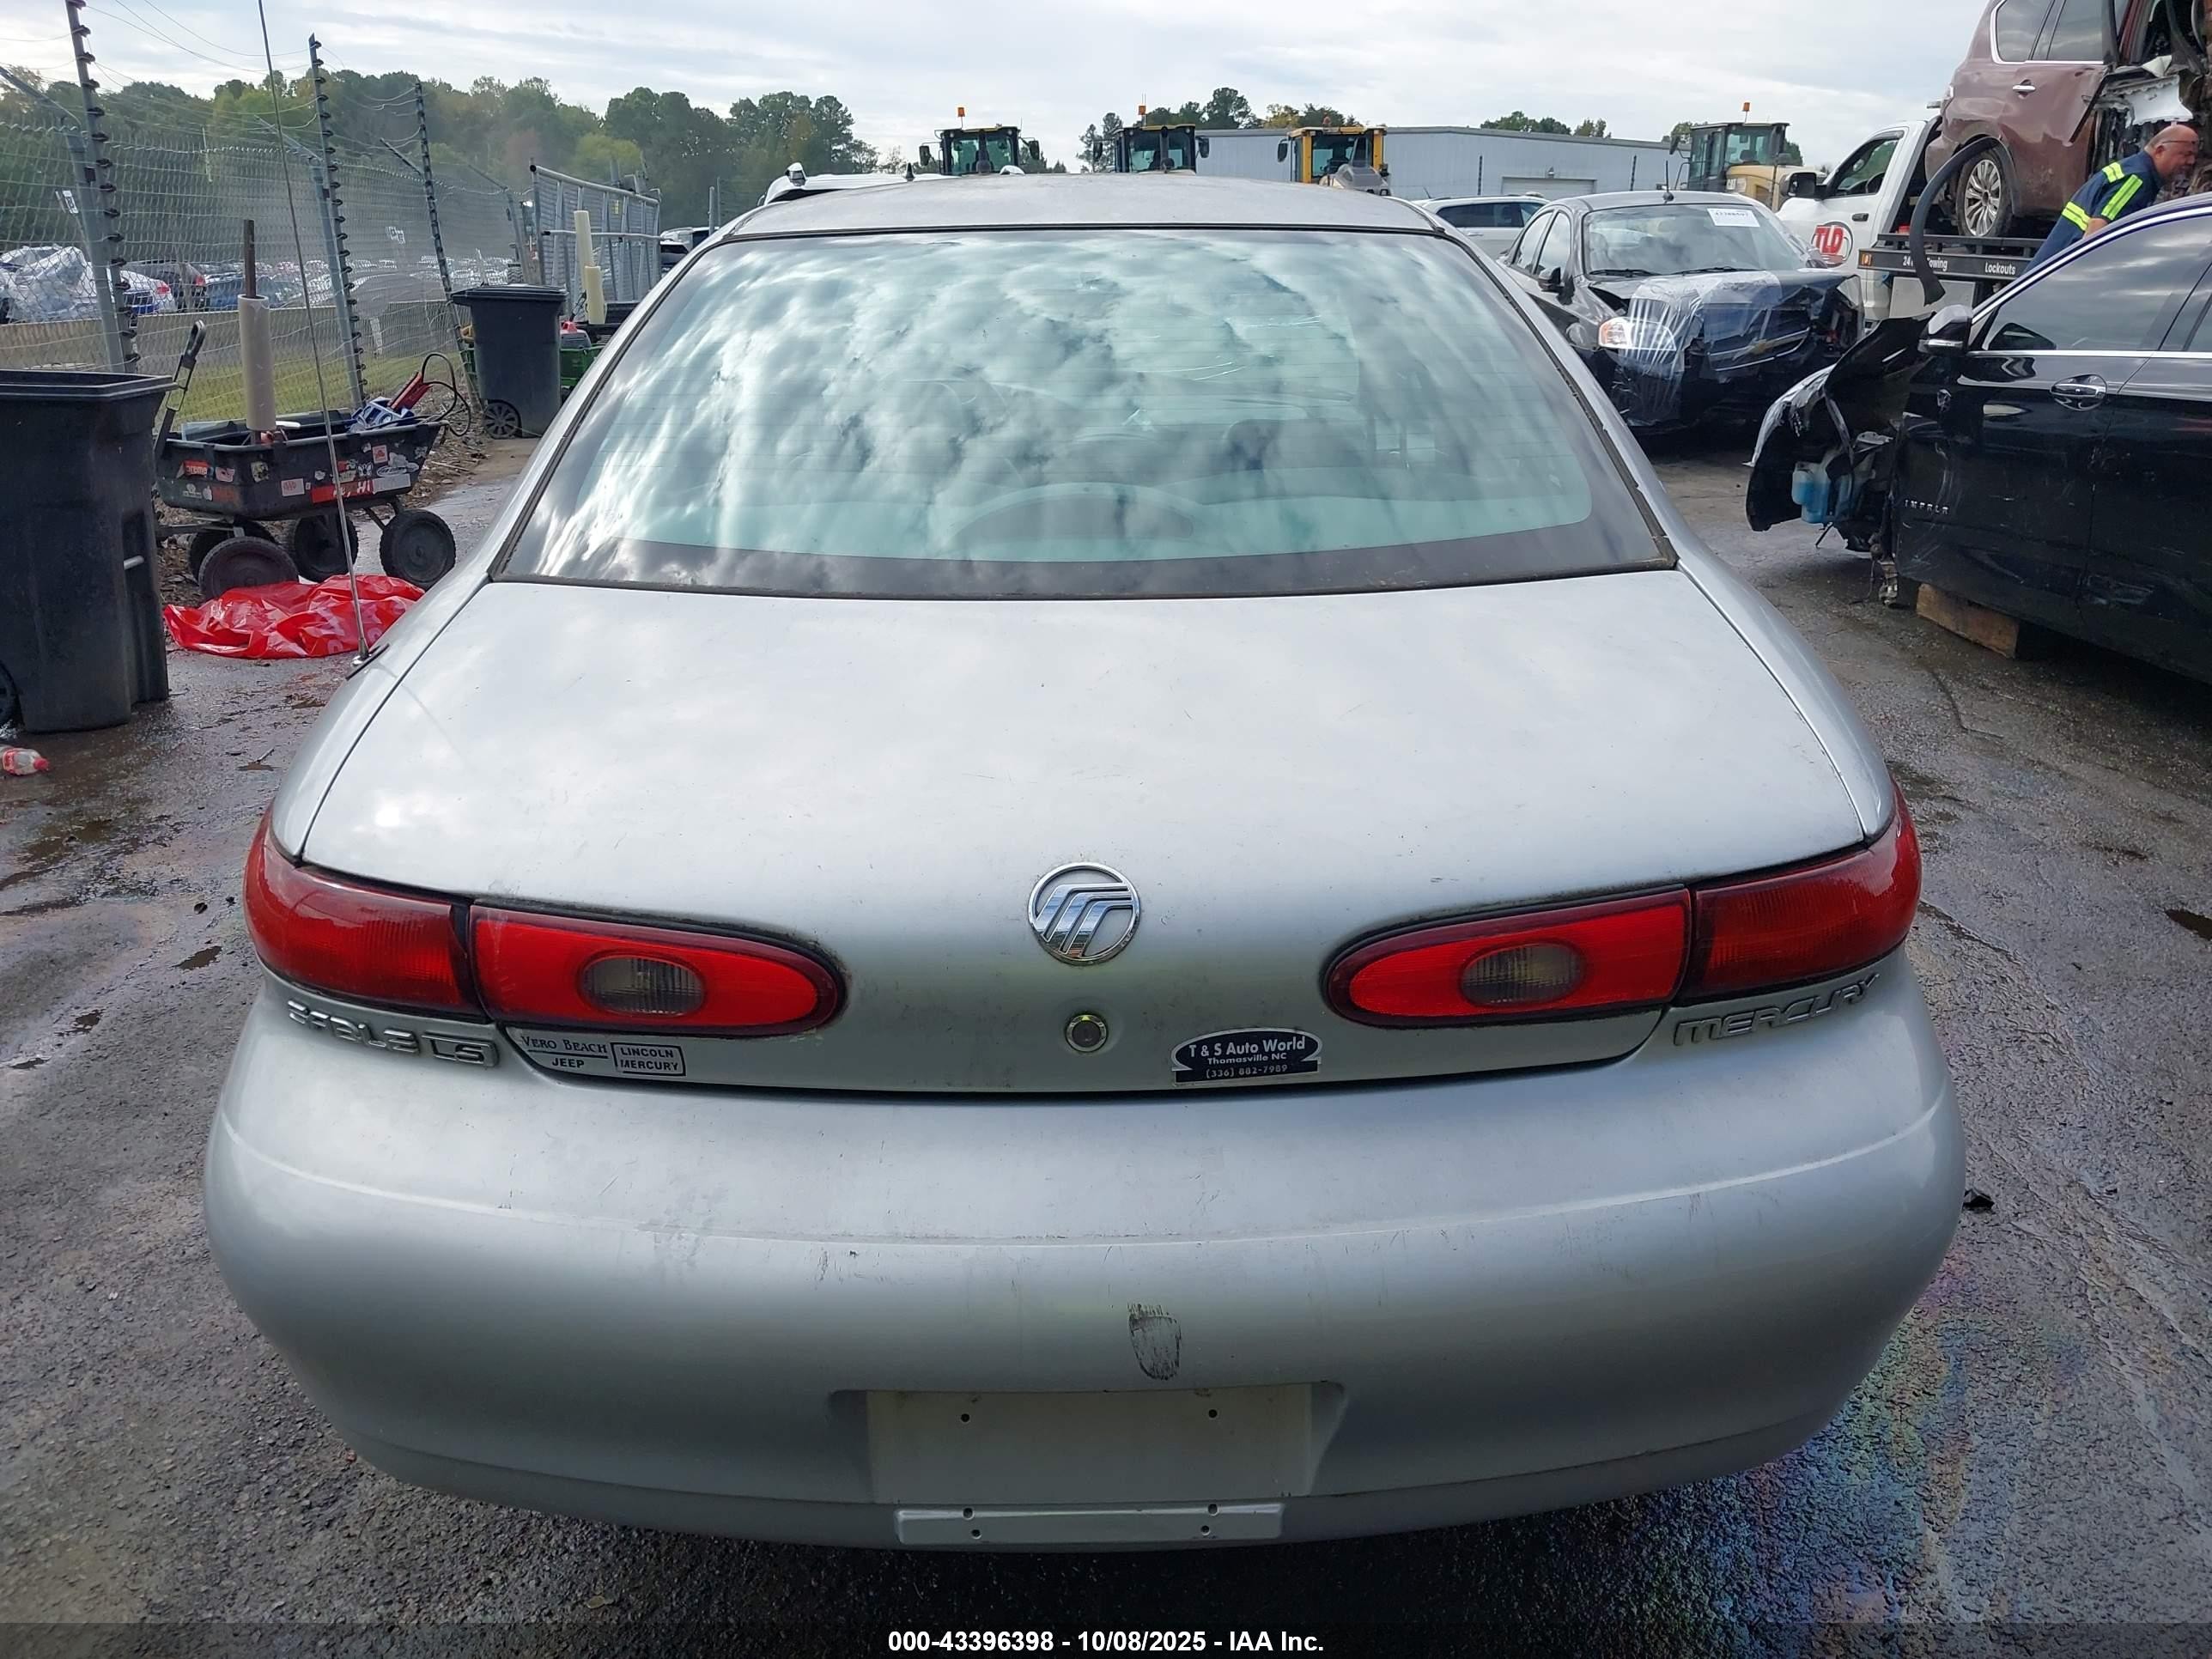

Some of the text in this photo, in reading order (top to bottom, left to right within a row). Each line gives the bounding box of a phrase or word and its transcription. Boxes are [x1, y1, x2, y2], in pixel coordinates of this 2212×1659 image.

[1926, 257, 1948, 272] owing
[1984, 261, 2016, 276] Lockouts
[1904, 499, 1950, 515] IMPALA
[1673, 972, 1881, 1047] MERCURY
[287, 1000, 421, 1054] SABLE
[520, 1036, 608, 1054] VERO BEACH
[620, 1047, 674, 1059] LINCOLN
[1188, 1036, 1306, 1058] T & S Auto World
[551, 1057, 586, 1069] JEEP
[620, 1059, 678, 1072] MERCURY
[1206, 1052, 1287, 1066] Thomasville NC
[1206, 1066, 1235, 1079] (336)
